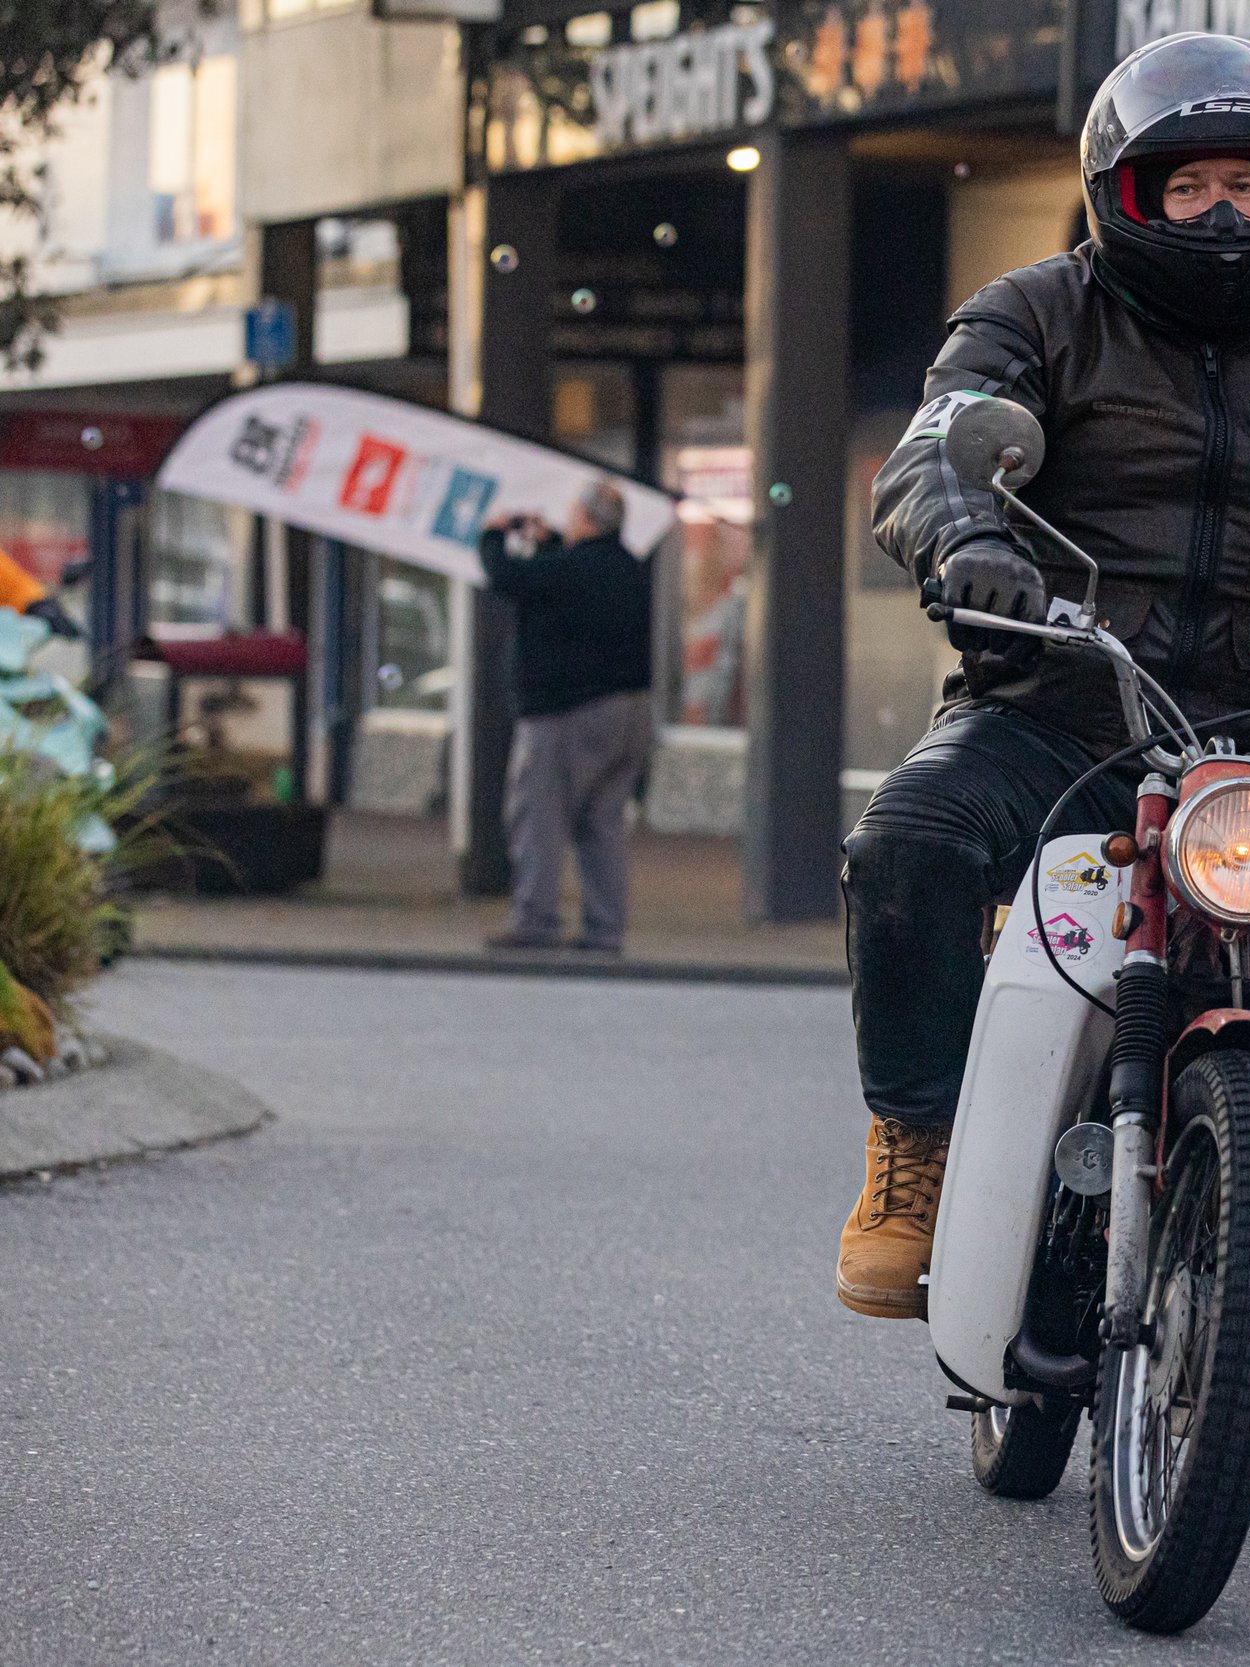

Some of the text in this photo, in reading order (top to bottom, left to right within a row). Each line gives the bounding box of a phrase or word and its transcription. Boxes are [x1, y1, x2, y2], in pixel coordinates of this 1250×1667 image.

[1052, 872, 1079, 882] Scooter
[1063, 881, 1084, 891] Safari
[1032, 934, 1061, 944] Scter
